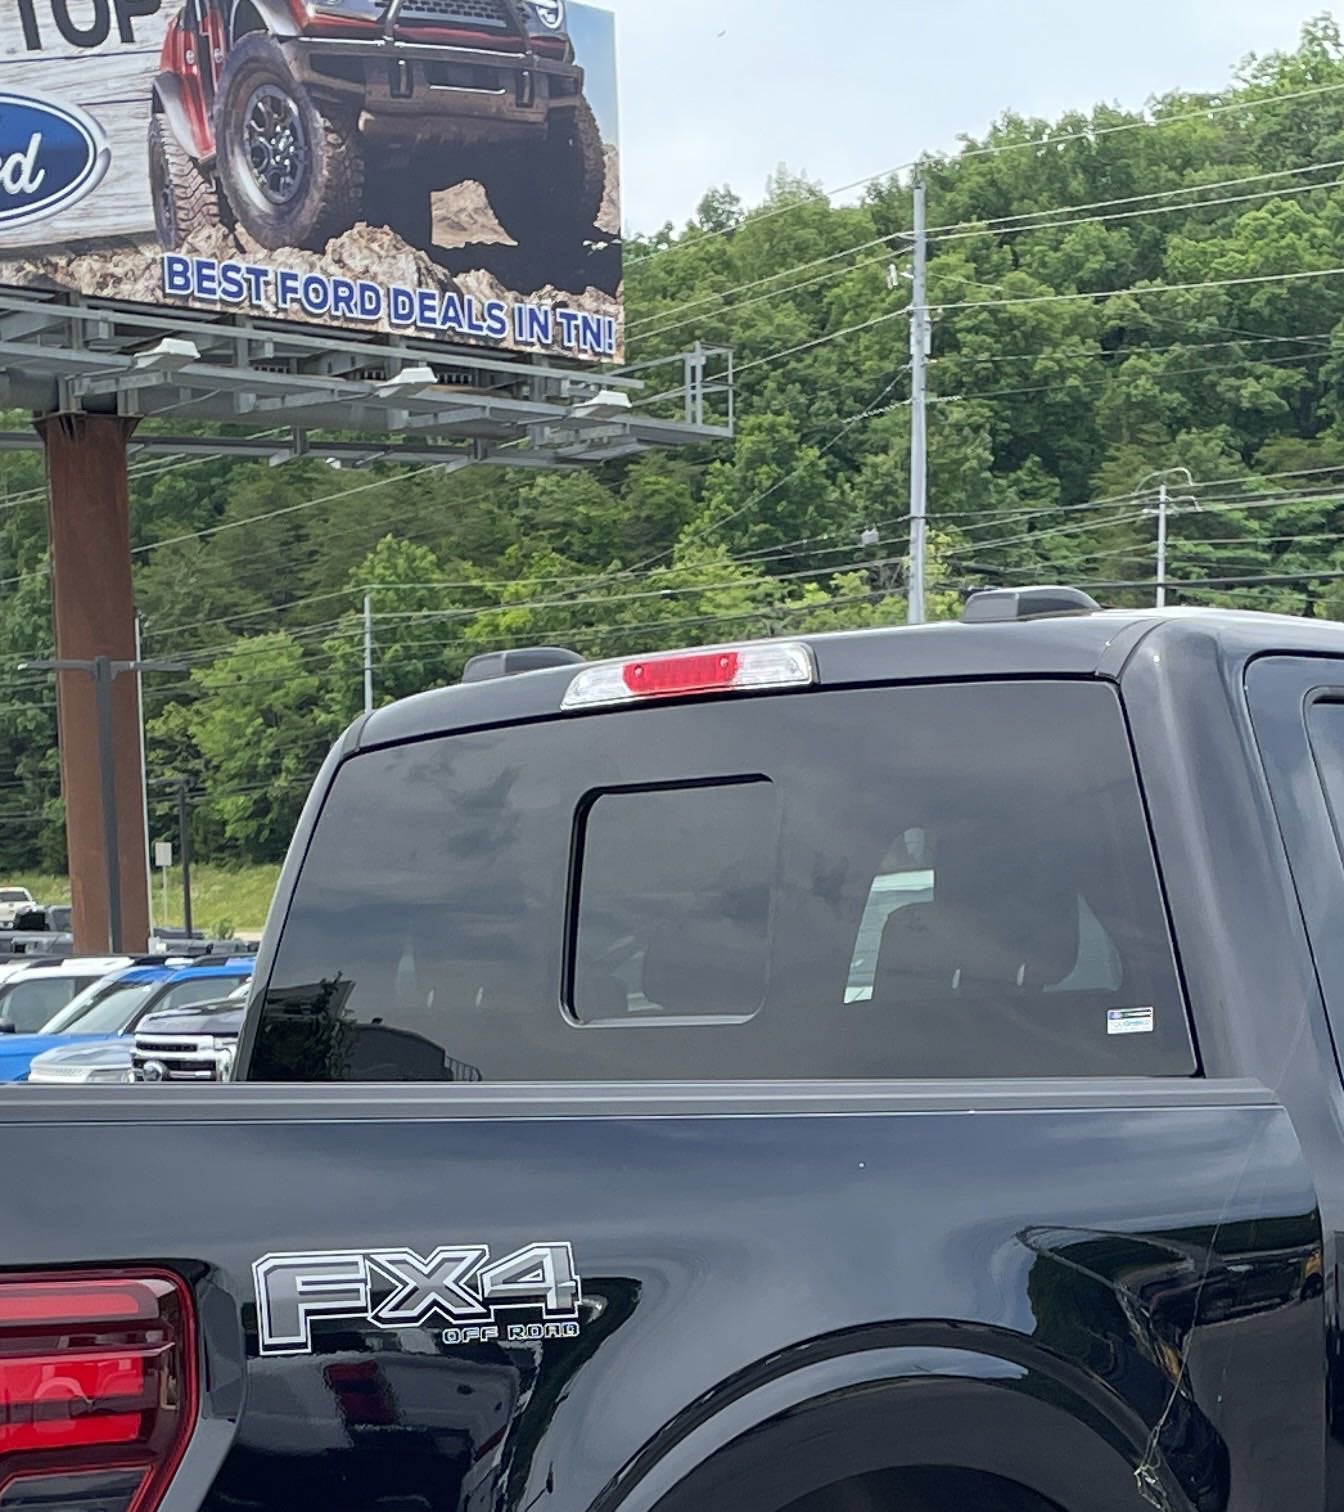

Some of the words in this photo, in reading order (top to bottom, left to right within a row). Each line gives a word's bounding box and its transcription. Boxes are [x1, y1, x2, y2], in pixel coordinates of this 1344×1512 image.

[163, 251, 270, 305] BEST
[276, 267, 383, 322] FORD
[389, 286, 508, 339] DEALS
[515, 303, 553, 346] IN
[557, 308, 617, 354] TN!
[252, 1241, 582, 1356] FX4
[442, 1326, 498, 1345] OFF
[506, 1321, 580, 1341] ROAD
